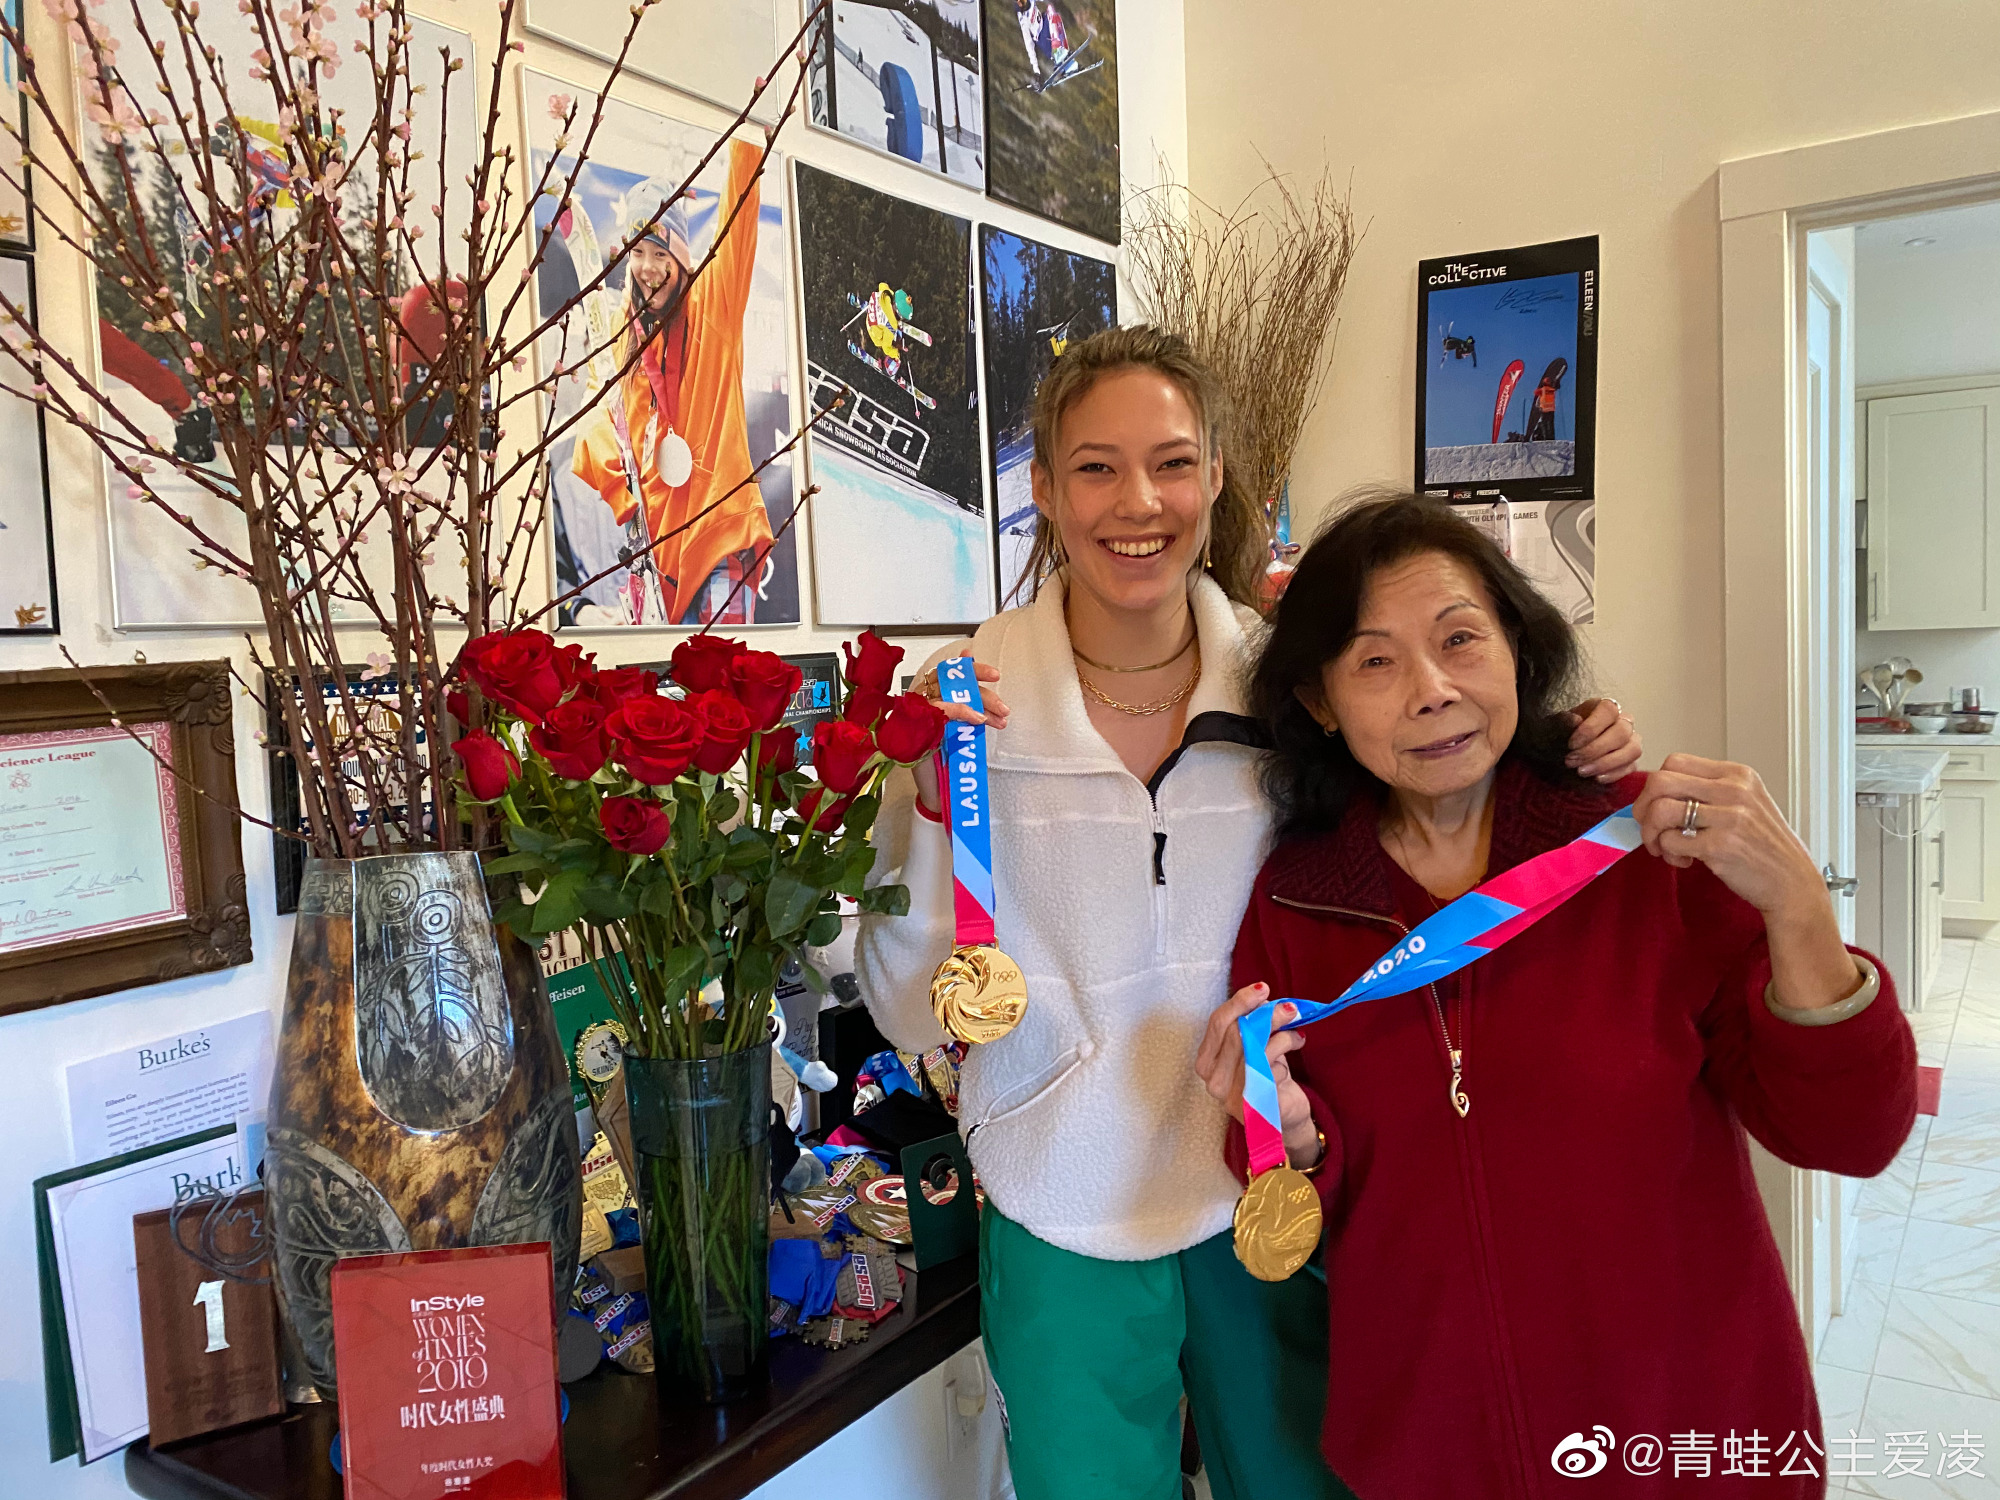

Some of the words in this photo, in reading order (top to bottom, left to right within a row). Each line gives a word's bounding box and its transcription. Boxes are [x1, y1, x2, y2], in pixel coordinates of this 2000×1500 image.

[834, 426, 876, 456] SNOWBOARD
[876, 450, 917, 478] ASSOCIATION
[1513, 512, 1538, 520] GAMES
[795, 707, 832, 717] CHAMPIONSHIPS
[0, 757, 45, 768] cience
[48, 750, 96, 763] League
[950, 689, 981, 828] LAUSANE
[138, 1032, 211, 1070] Burke's
[592, 1064, 615, 1077] SKIING
[193, 1280, 230, 1353] 1
[411, 1293, 485, 1313] InStyle
[412, 1313, 485, 1339] WOMEN
[416, 1356, 488, 1394] 2019
[400, 1394, 505, 1429] 时代女性盛典
